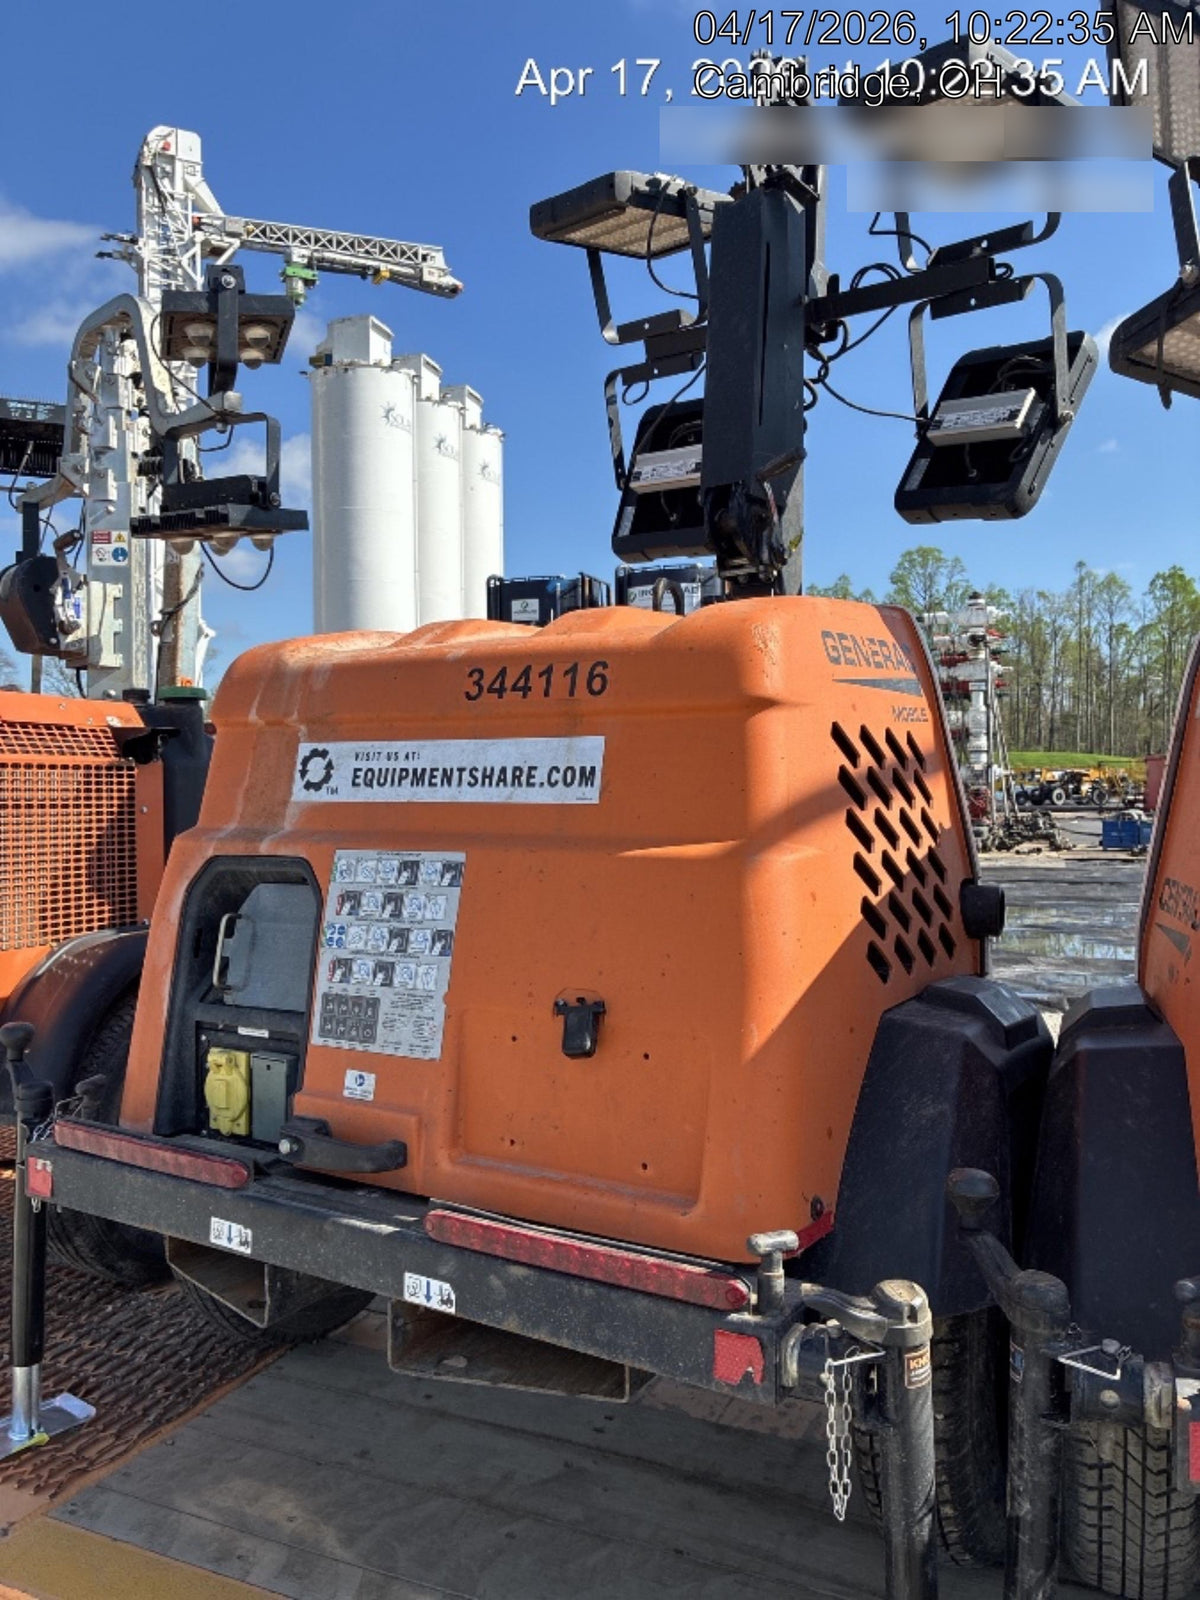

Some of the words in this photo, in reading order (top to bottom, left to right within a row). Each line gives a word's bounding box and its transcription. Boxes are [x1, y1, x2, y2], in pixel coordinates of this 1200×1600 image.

[464, 660, 609, 702] 344116
[355, 751, 382, 762] VISIT
[386, 751, 399, 762] US
[403, 751, 421, 762] AT:
[351, 765, 597, 790] EQUIPMENTSHARE.COM
